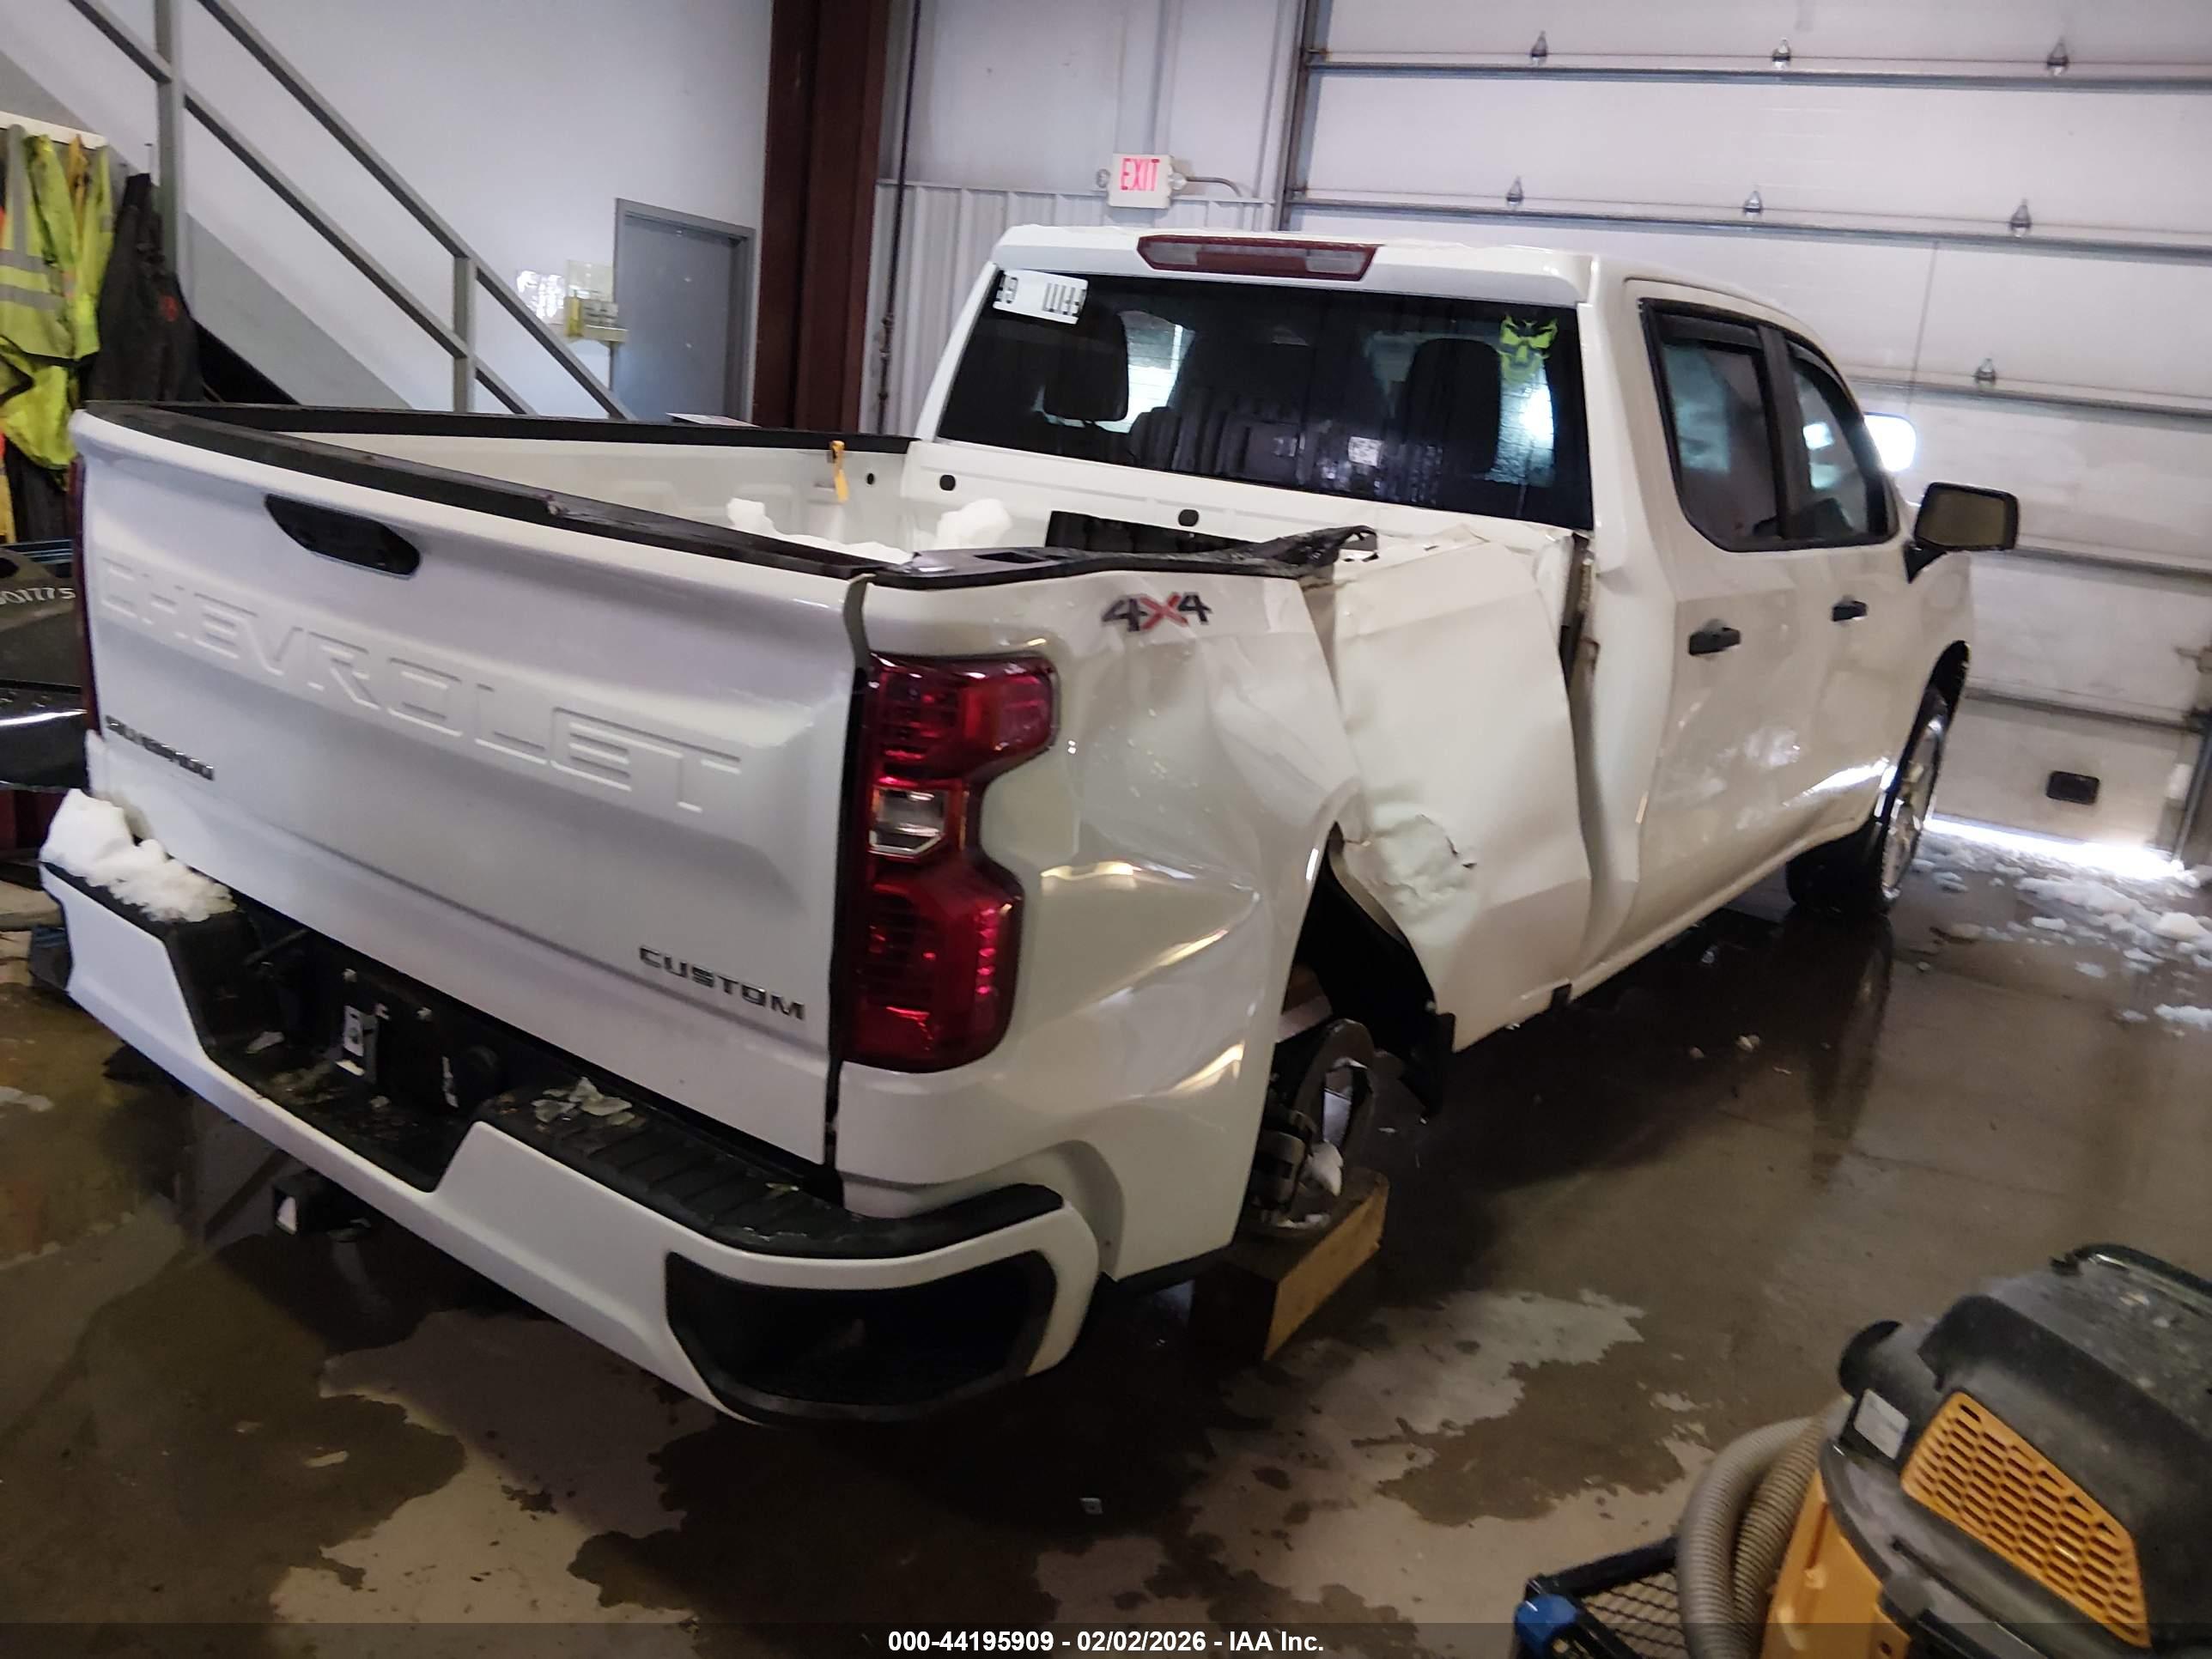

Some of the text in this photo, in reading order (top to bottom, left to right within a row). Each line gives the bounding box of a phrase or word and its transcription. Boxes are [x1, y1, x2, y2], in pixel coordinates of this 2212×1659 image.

[1120, 156, 1160, 191] EXIT
[100, 556, 742, 814] CHEVROLET
[638, 945, 805, 1020] CUSTOM
